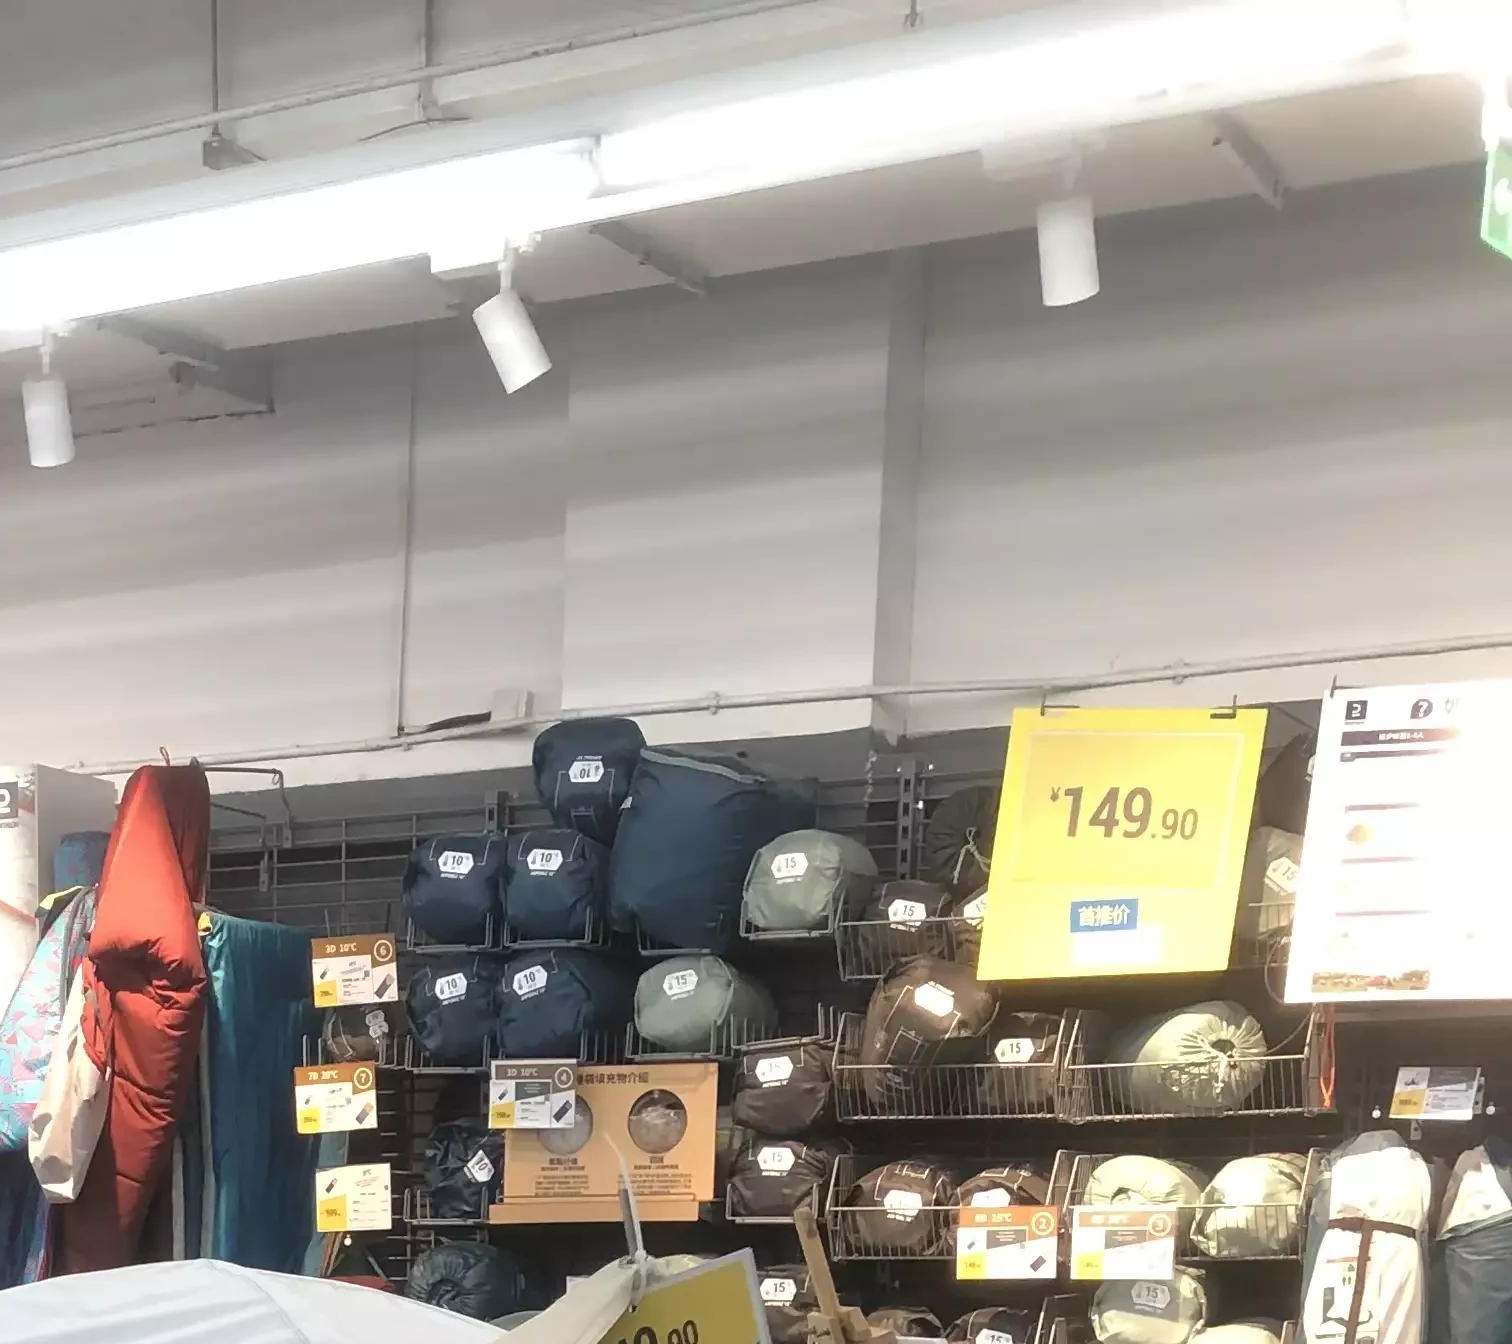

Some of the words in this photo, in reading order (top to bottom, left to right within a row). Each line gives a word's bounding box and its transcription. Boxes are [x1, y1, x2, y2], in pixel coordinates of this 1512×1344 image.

[1050, 786, 1199, 841] ¥149.90
[451, 855, 464, 866] 10
[540, 852, 552, 863] 10
[785, 858, 797, 869] 15
[902, 904, 916, 917] 15
[1078, 903, 1131, 927] 首推价
[523, 971, 536, 984] 10
[675, 975, 687, 986] 15
[446, 978, 458, 990] 10
[1009, 1042, 1021, 1054] 15
[774, 1282, 786, 1293] 15
[1145, 1285, 1158, 1299] 15
